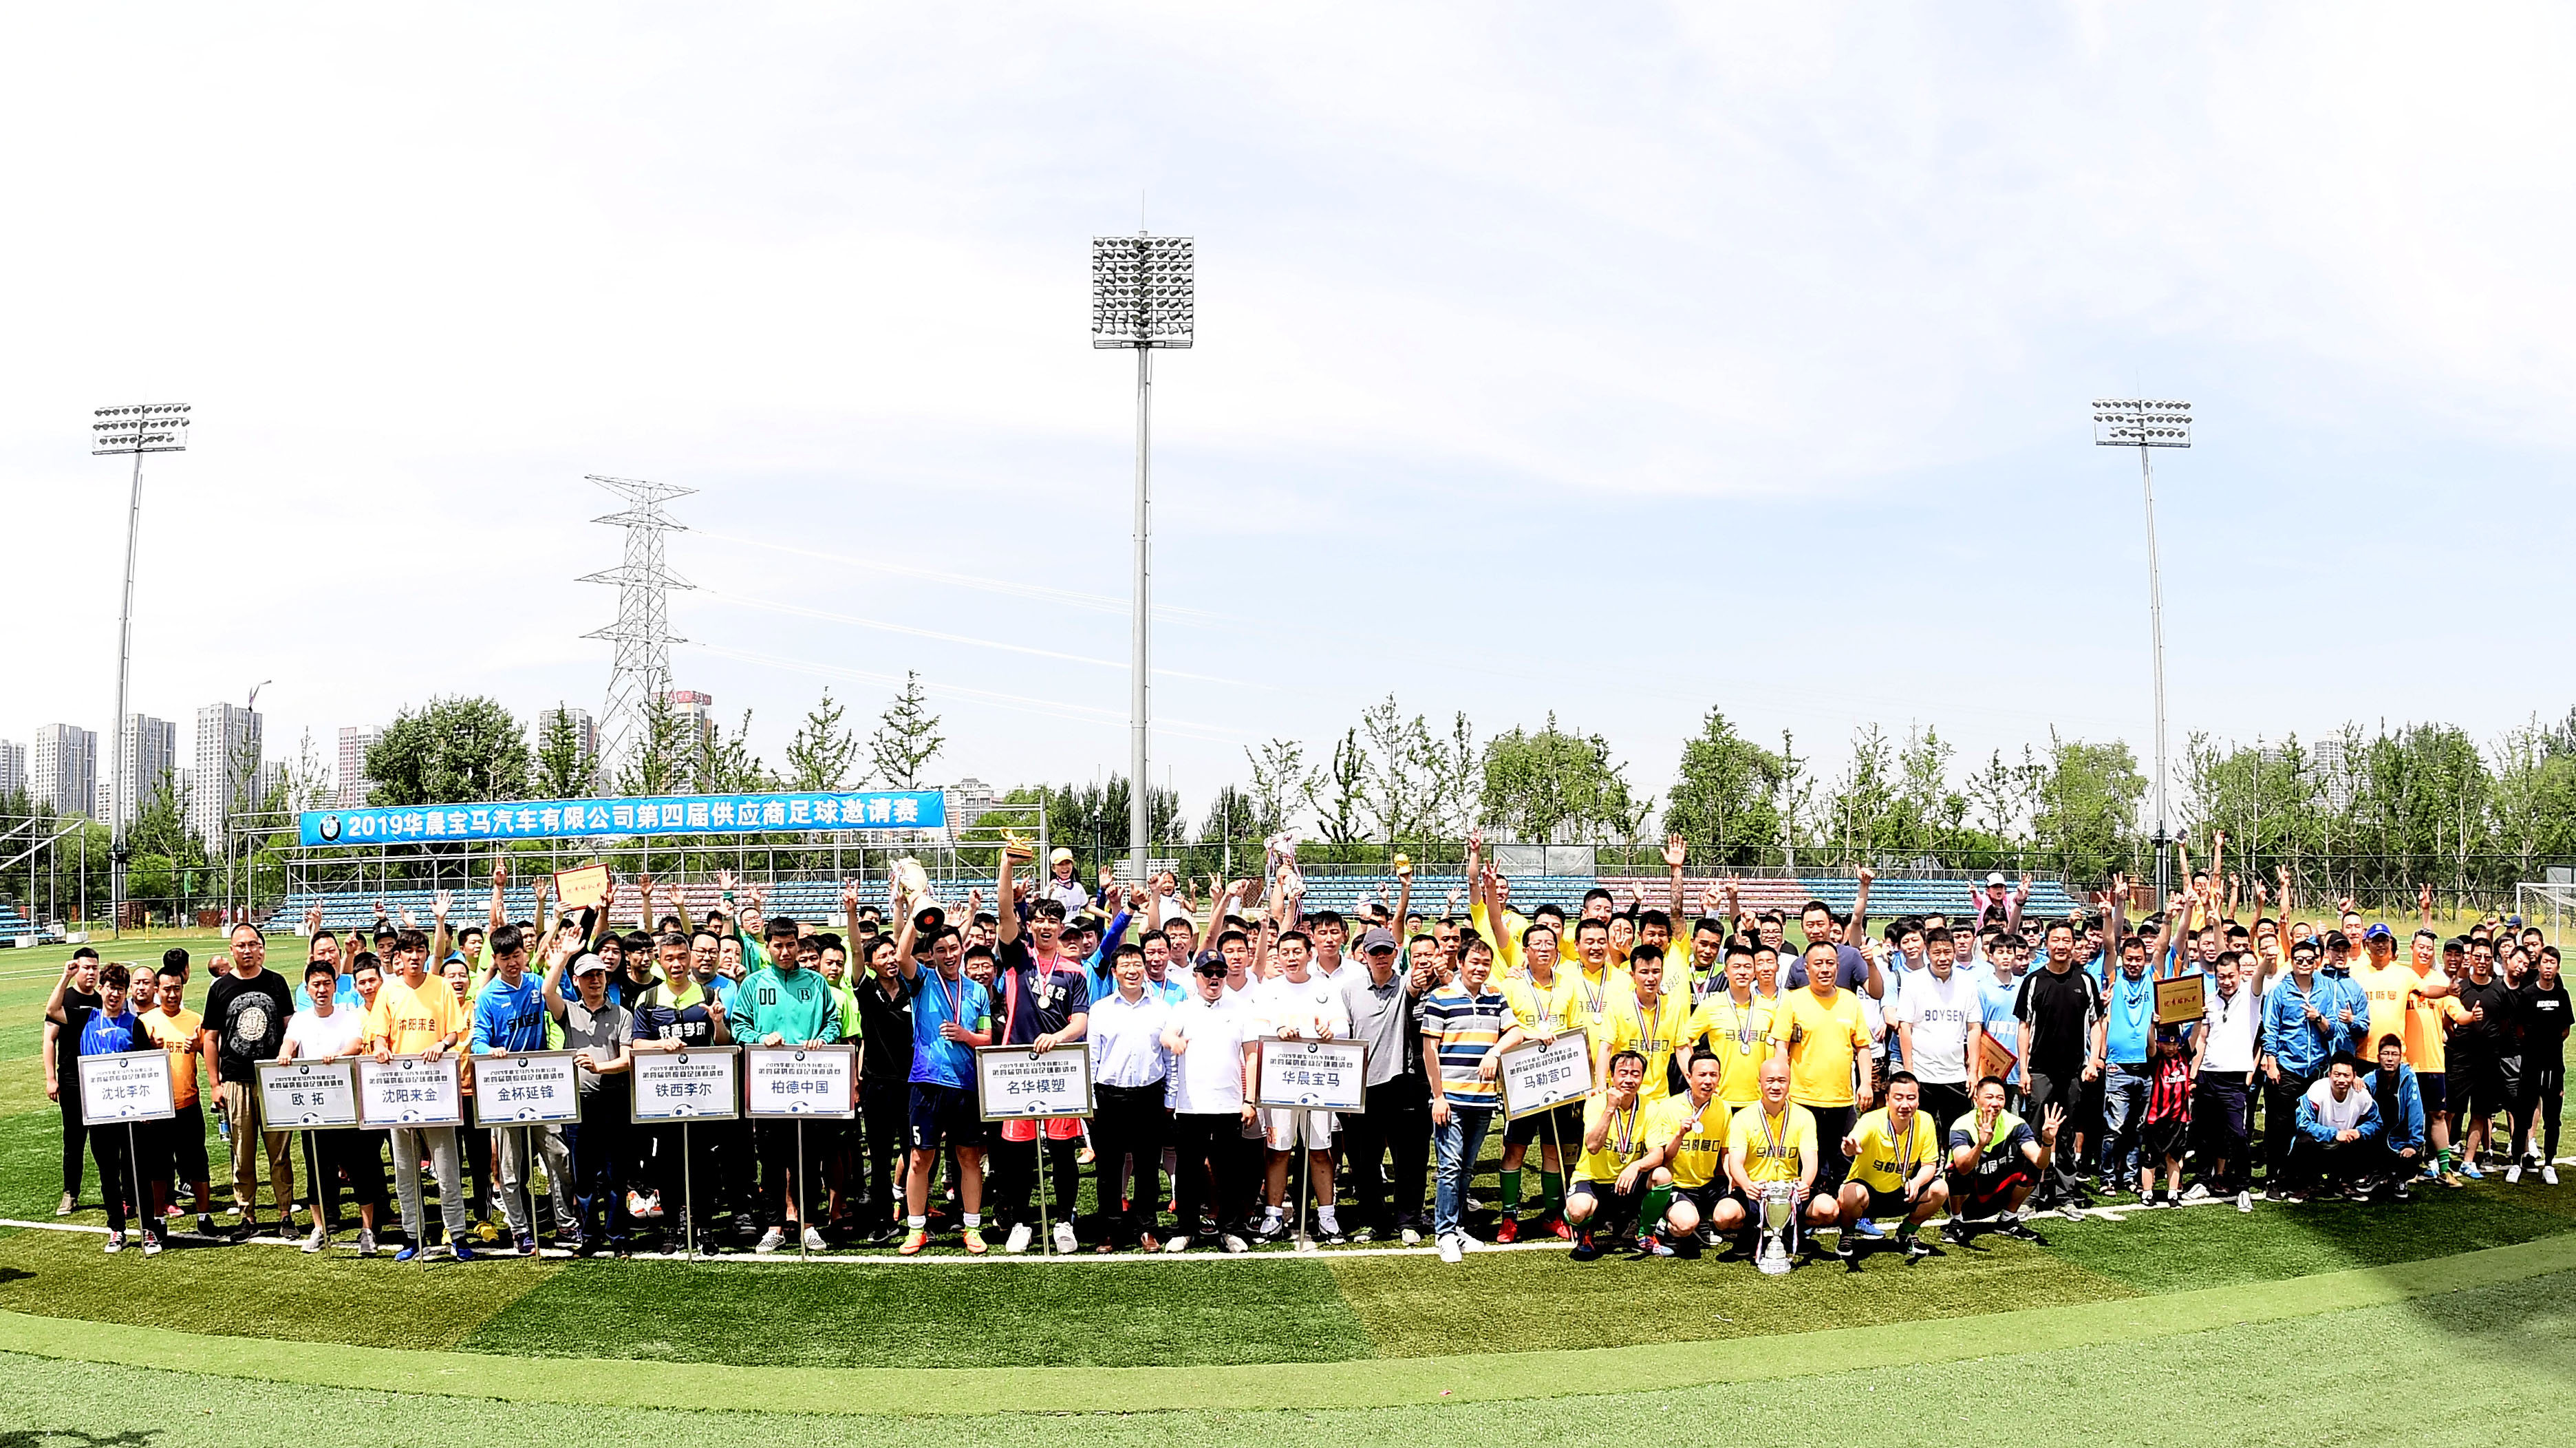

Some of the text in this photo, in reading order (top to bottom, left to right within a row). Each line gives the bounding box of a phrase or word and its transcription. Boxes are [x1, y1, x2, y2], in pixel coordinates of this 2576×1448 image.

[347, 798, 919, 837] 2019华晨宝马汽车有限公司第四届供应商足球邀请赛
[759, 988, 776, 1005] 00
[398, 1018, 436, 1032] 沈阳来金
[1282, 1071, 1340, 1087] 华晨宝马
[1523, 1066, 1571, 1089] 马勒营口
[102, 1084, 151, 1100] 沈北李尔
[497, 1085, 555, 1102] 金杯延锋
[655, 1082, 712, 1098] 铁西李尔
[771, 1080, 828, 1094] 柏德中国
[1007, 1078, 1066, 1095] 名华模塑
[382, 1088, 438, 1103] 沈阳来金
[912, 1125, 921, 1146] 5
